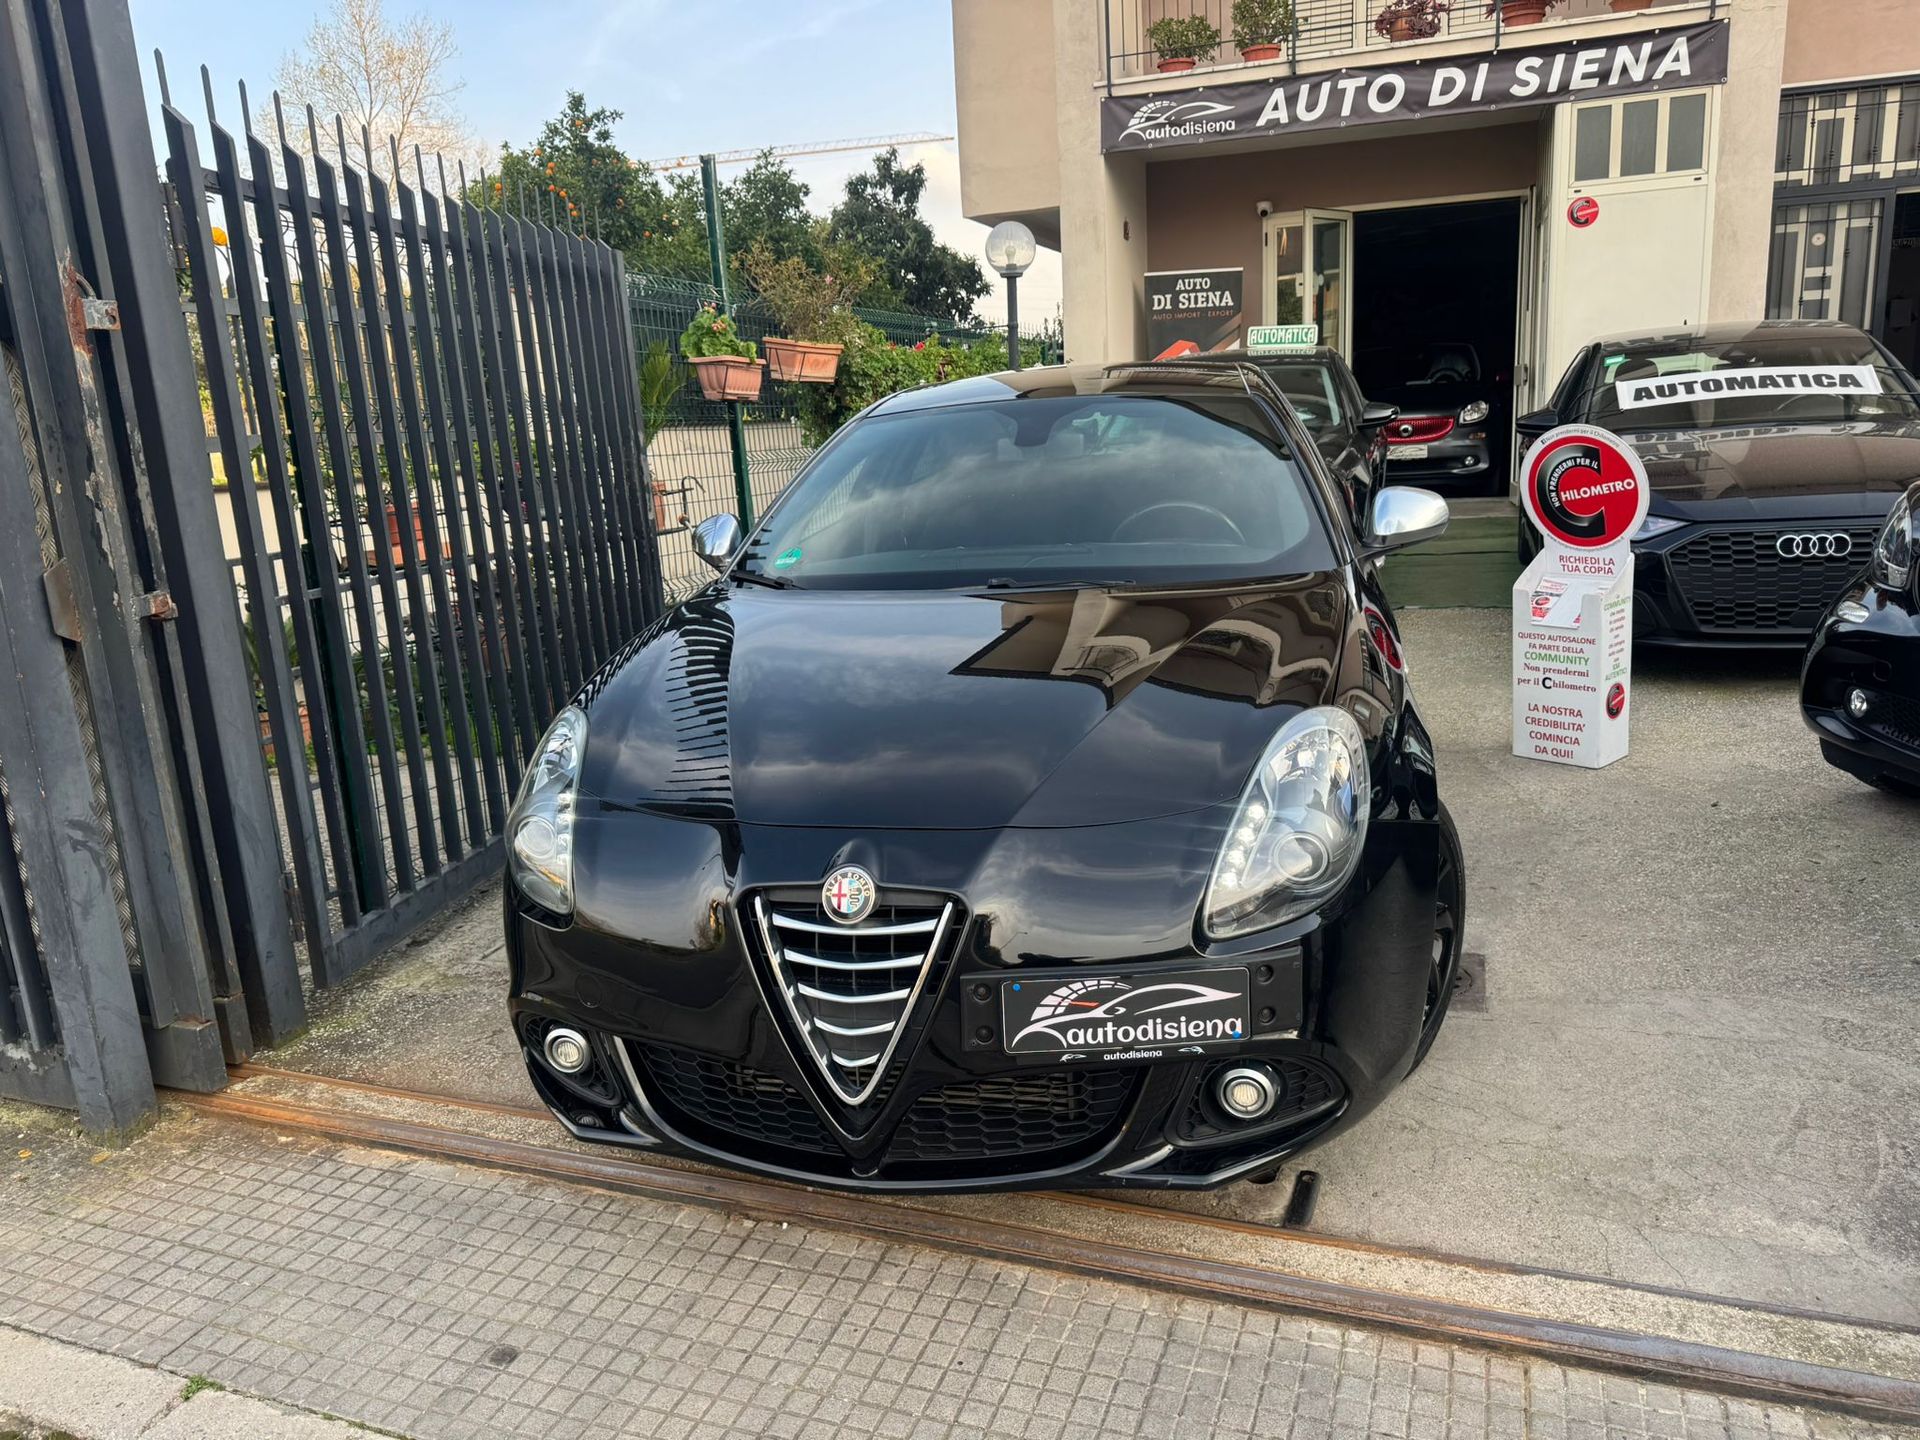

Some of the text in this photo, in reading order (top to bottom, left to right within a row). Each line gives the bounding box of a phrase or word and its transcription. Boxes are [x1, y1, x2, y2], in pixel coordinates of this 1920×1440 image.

[1256, 36, 1693, 127] AUTO DI SIENA
[1145, 118, 1236, 139] autodisiena
[1175, 277, 1211, 291] AUTO
[1152, 290, 1234, 311] DI SIENA
[1153, 312, 1173, 321] AUTO
[1174, 311, 1201, 320] IMPORT
[1250, 327, 1316, 346] AUTOMATICA
[1633, 373, 1863, 401] AUTOMATICA
[1576, 458, 1591, 466] PER
[1559, 555, 1615, 566] RICHIEDI LA
[1561, 564, 1614, 575] TUA COPIA
[1518, 632, 1596, 645] QUESTO AUTOSALONE
[1538, 644, 1561, 652] PARTE
[1562, 646, 1584, 654] DELLA
[1524, 651, 1590, 666] COMMUNITY
[1523, 663, 1590, 678] Non prendermi
[1517, 677, 1532, 686] per
[1533, 677, 1539, 685] il
[1528, 703, 1583, 718] LA NOSTRA
[1529, 730, 1580, 746] COMINCIA
[1534, 745, 1574, 759] DA QUI!
[1066, 1016, 1243, 1046] autodisiena
[1103, 1049, 1163, 1061] autodisiena
